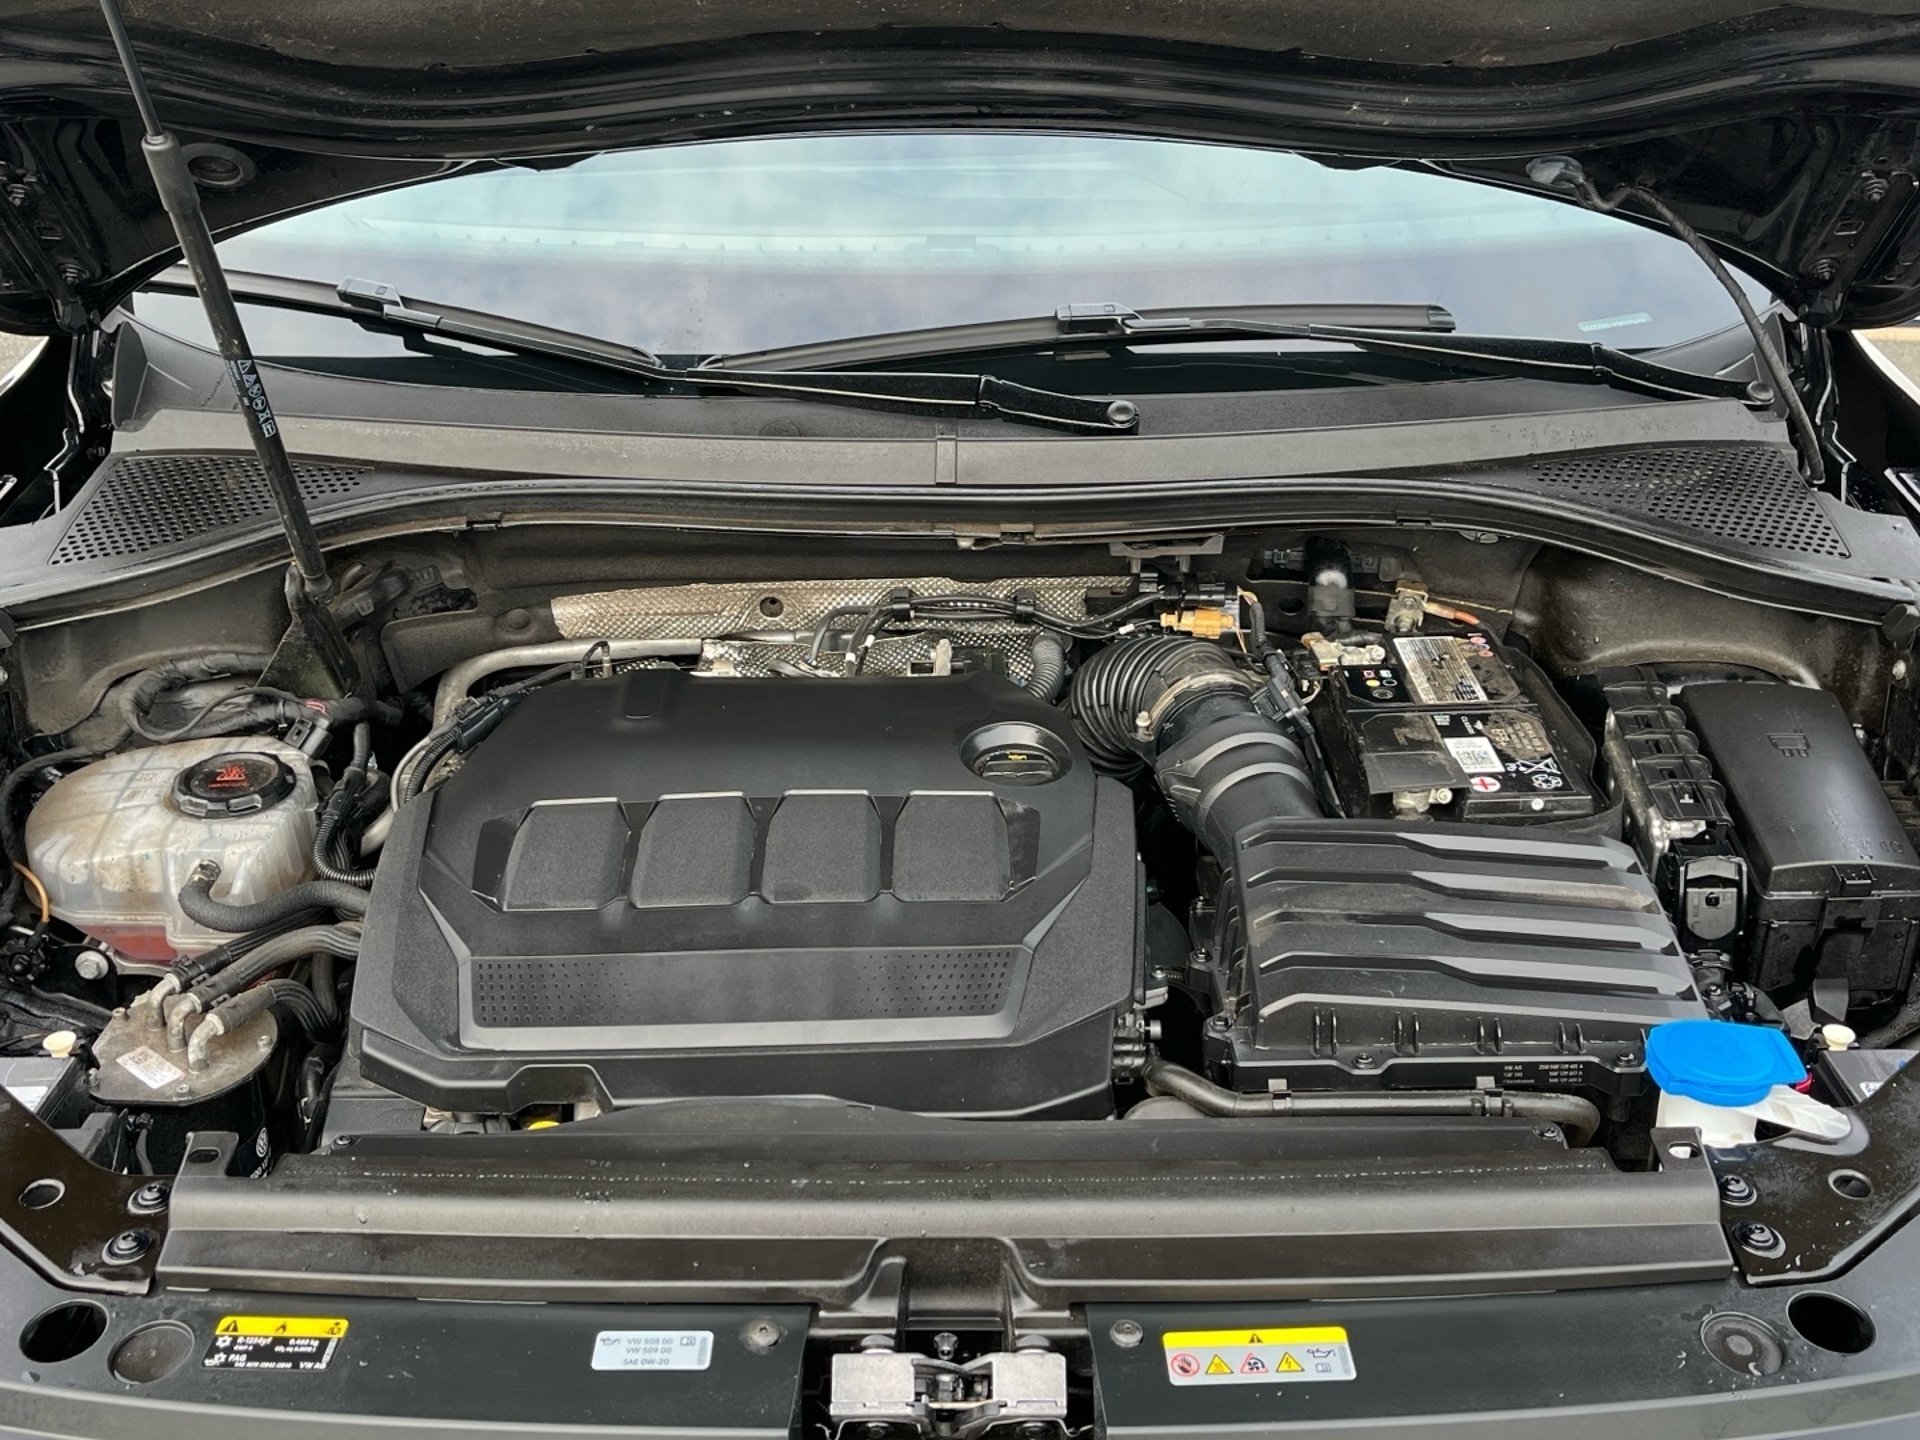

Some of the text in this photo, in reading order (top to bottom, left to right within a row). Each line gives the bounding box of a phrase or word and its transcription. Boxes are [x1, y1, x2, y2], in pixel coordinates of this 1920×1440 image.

[236, 1336, 273, 1347] R-1234yf
[228, 1353, 247, 1362] PAG
[299, 1361, 327, 1369] VW AG
[640, 1358, 670, 1366] 0W-20
